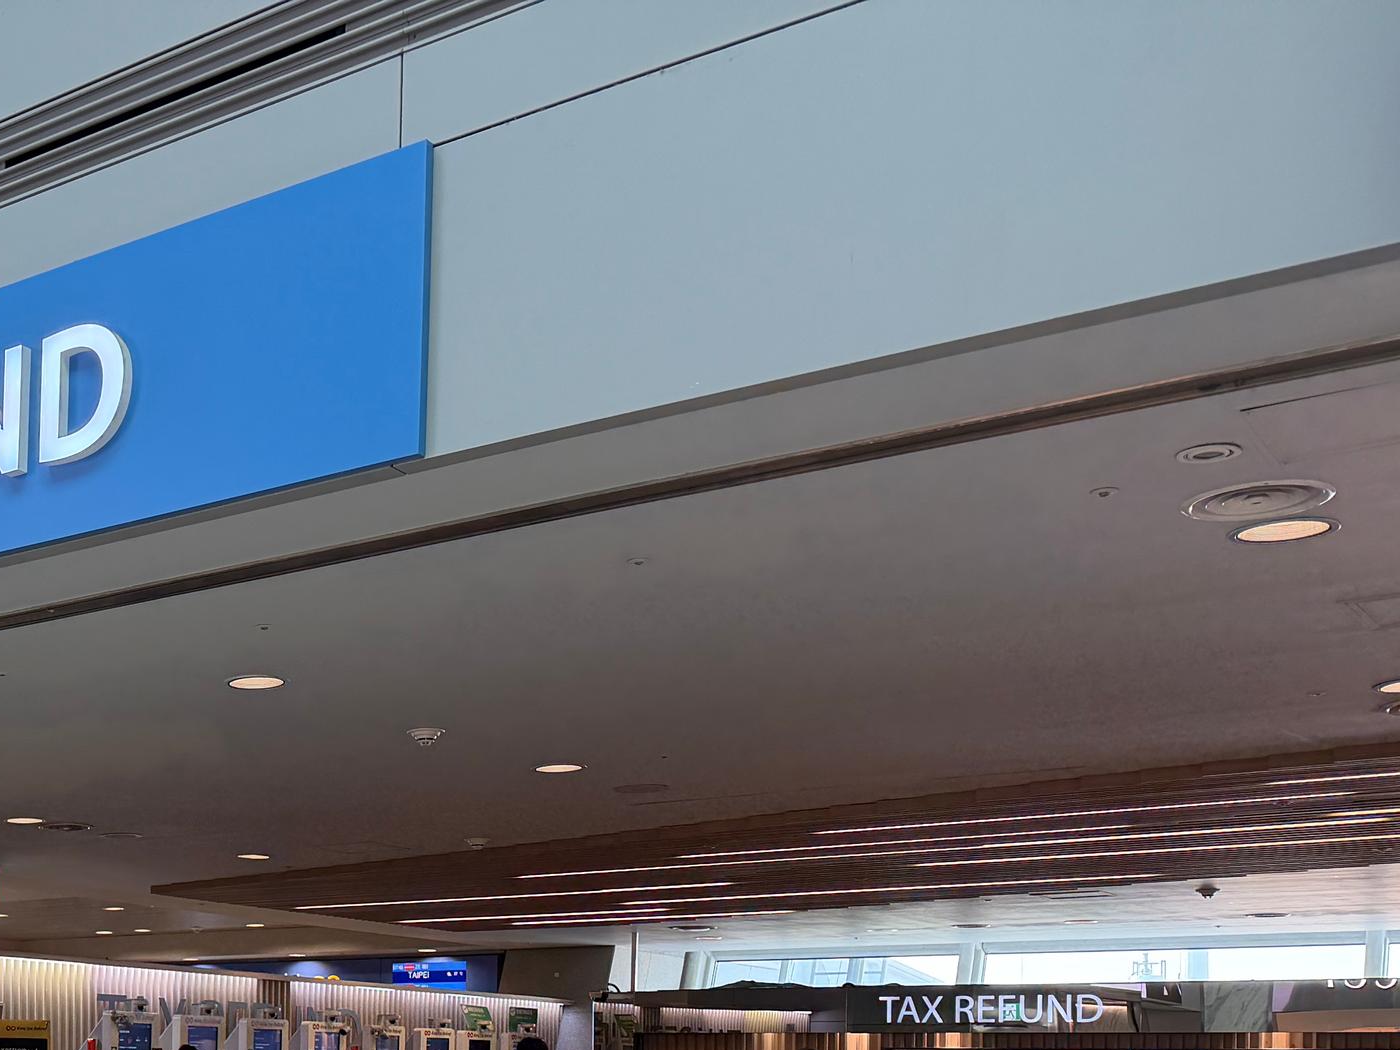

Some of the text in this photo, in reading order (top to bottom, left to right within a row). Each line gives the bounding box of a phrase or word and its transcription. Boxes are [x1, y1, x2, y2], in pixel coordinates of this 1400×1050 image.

[408, 971, 430, 979] TAIPEI
[879, 993, 1104, 1024] TAX REFUND
